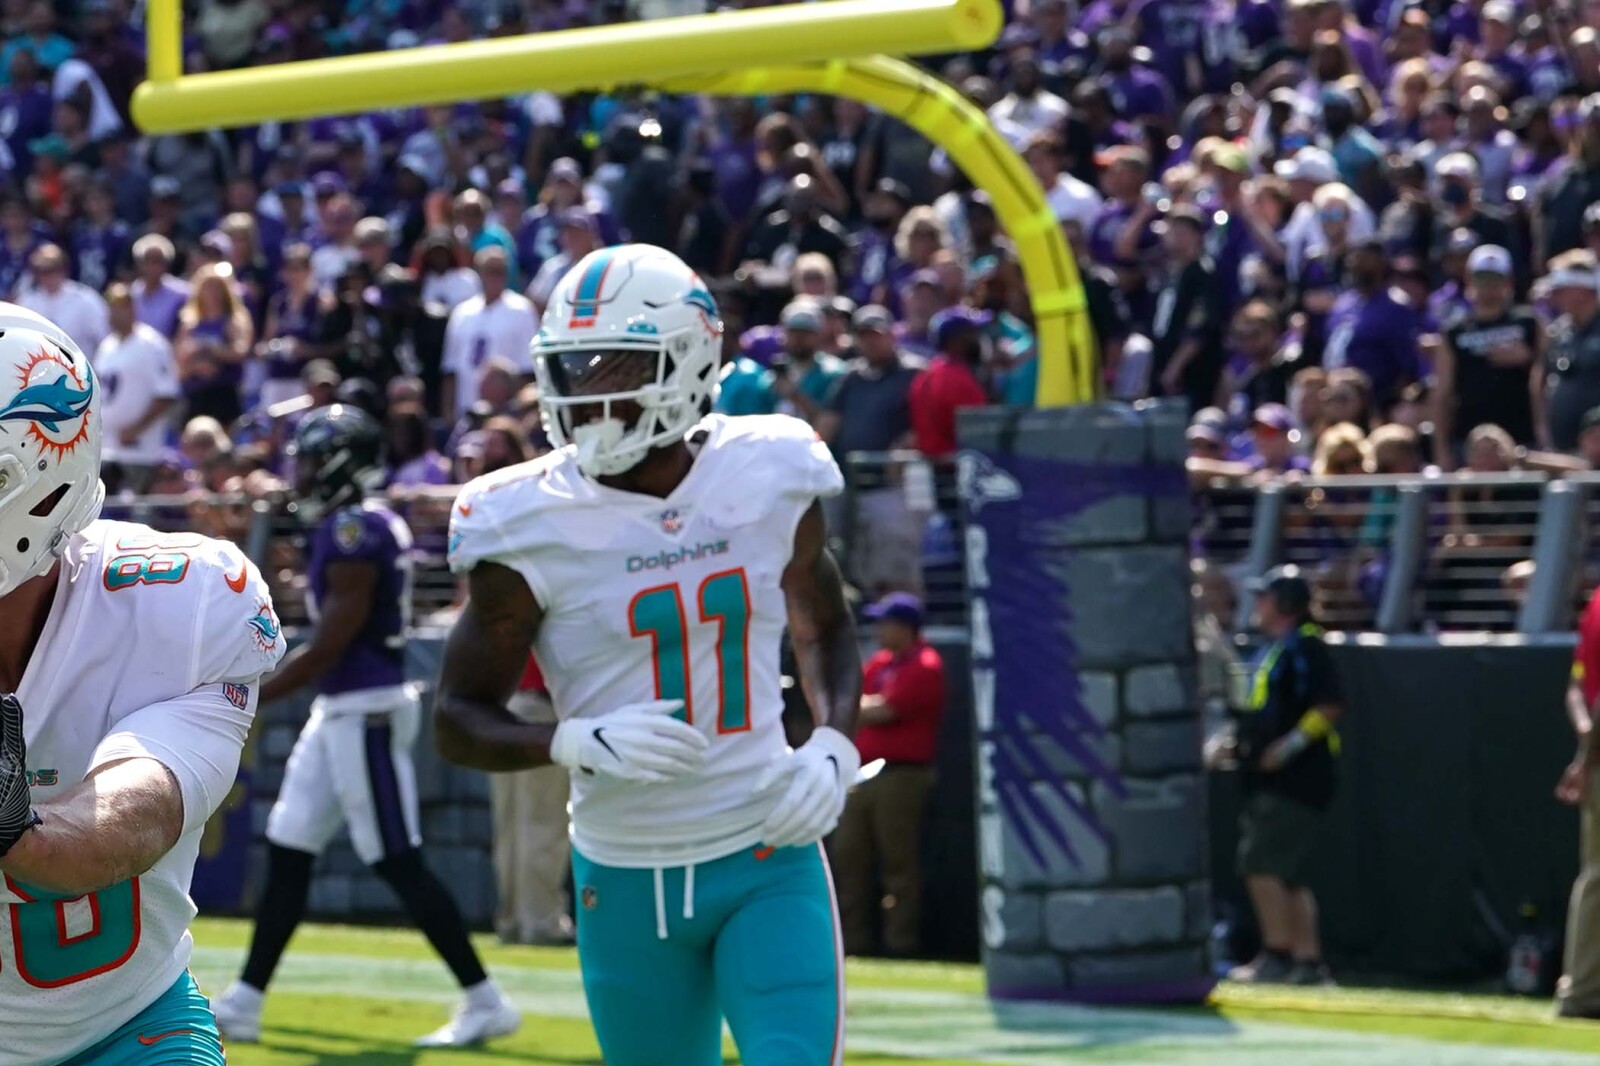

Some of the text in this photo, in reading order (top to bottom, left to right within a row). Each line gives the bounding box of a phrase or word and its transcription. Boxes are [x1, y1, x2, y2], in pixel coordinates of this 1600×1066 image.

[626, 539, 729, 573] Dolphins
[626, 566, 753, 737] 11
[226, 684, 248, 708] NFL
